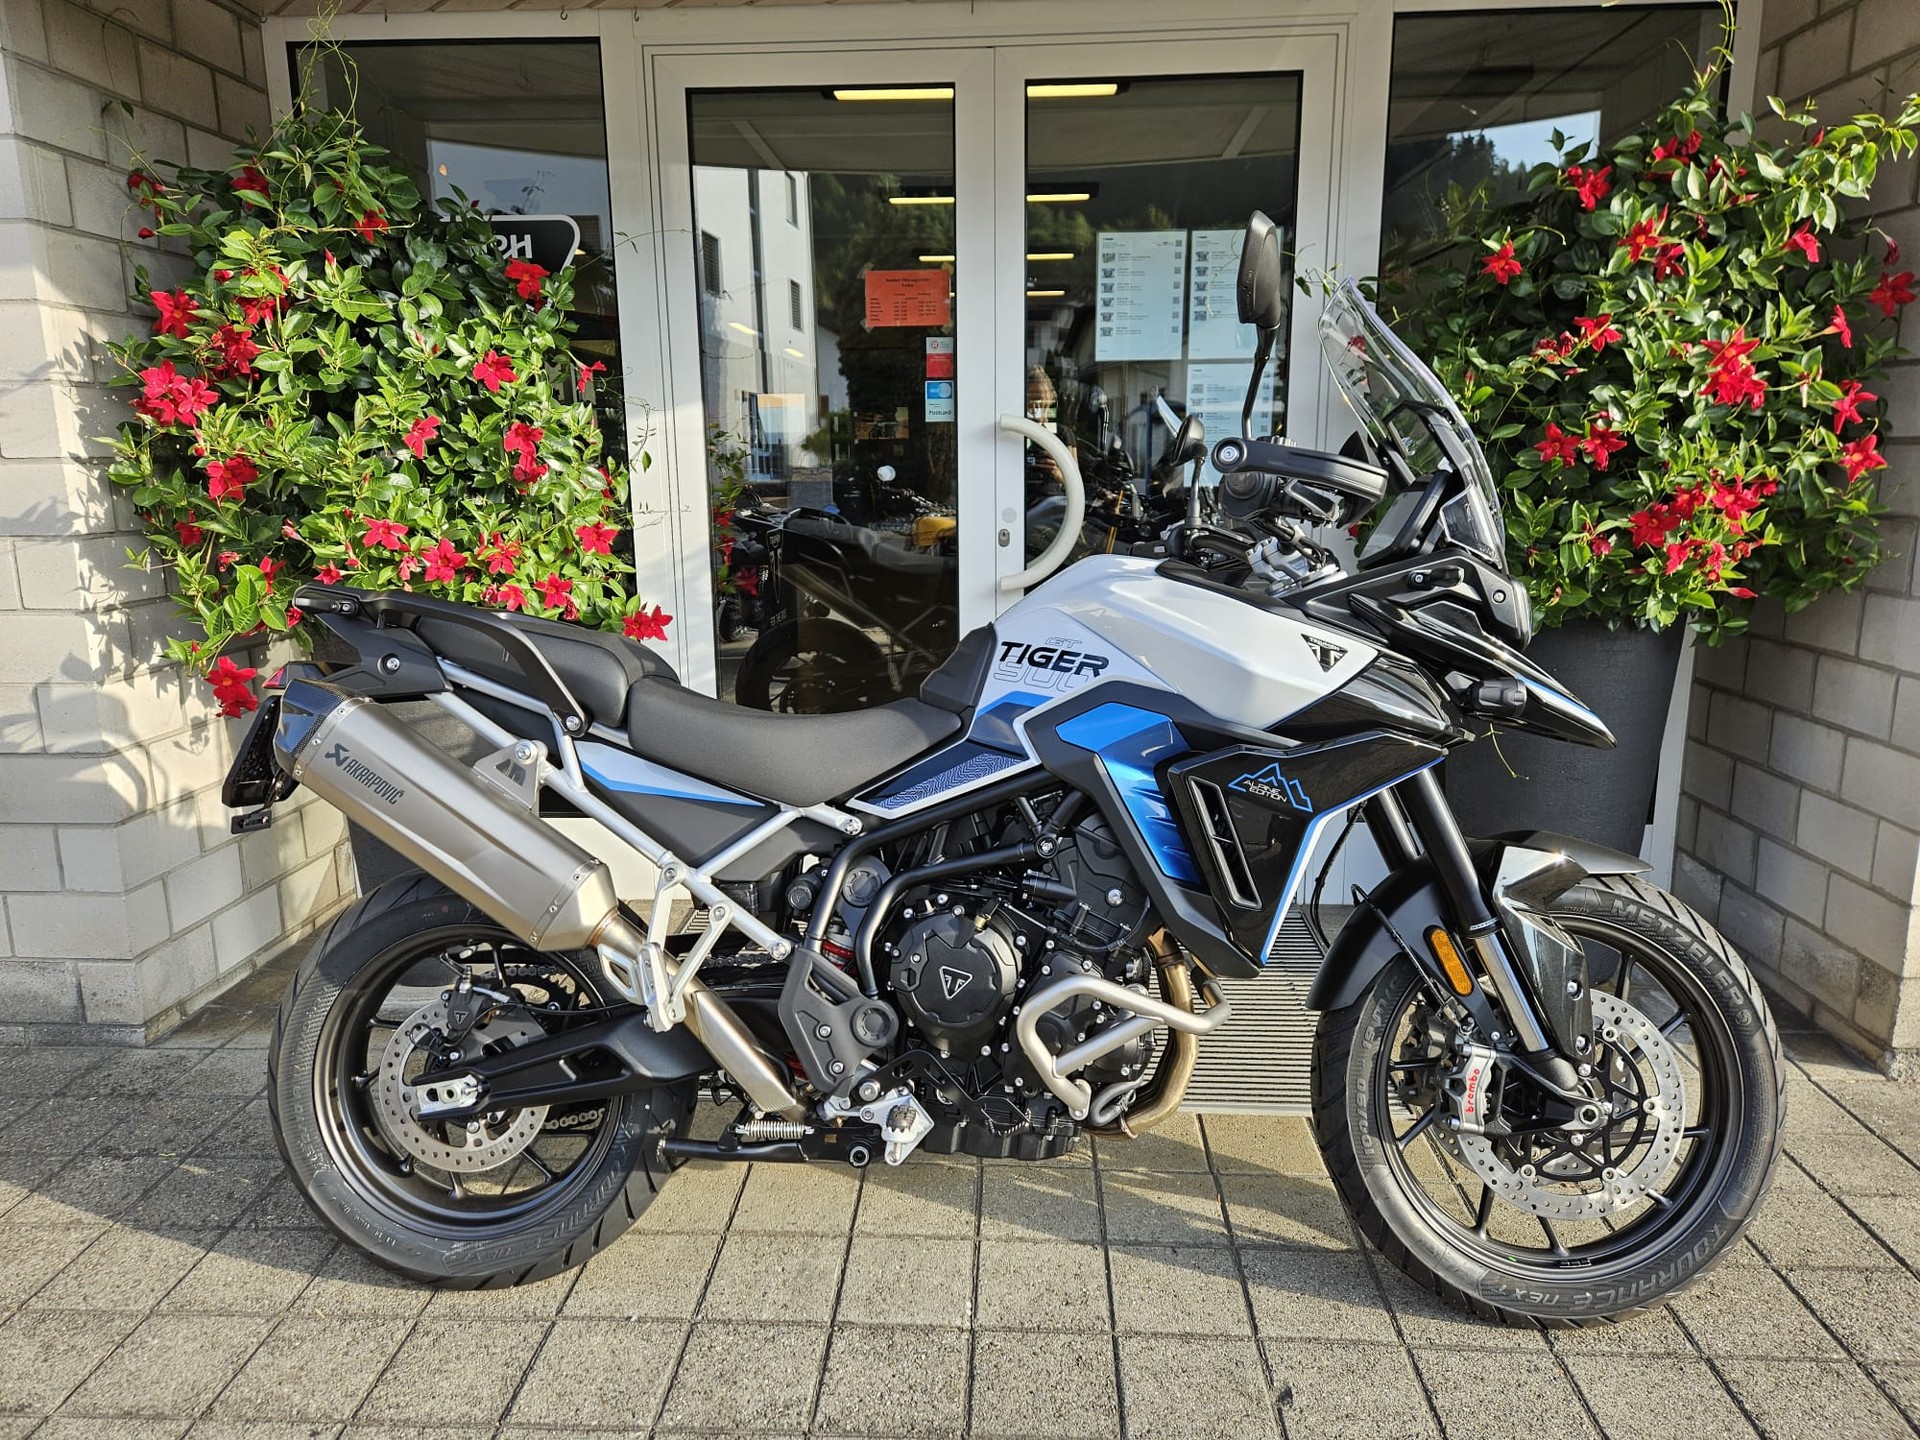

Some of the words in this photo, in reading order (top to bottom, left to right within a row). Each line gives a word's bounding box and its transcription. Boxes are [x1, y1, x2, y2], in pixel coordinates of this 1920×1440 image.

[1000, 641, 1109, 678] TIGER
[1045, 637, 1081, 648] GT
[1243, 780, 1281, 795] ALPINE
[1249, 786, 1287, 803] EDITION
[1610, 898, 1744, 1005] METZELER
[1464, 1068, 1480, 1114] brembo
[1569, 1224, 1729, 1311] TOURANCE
